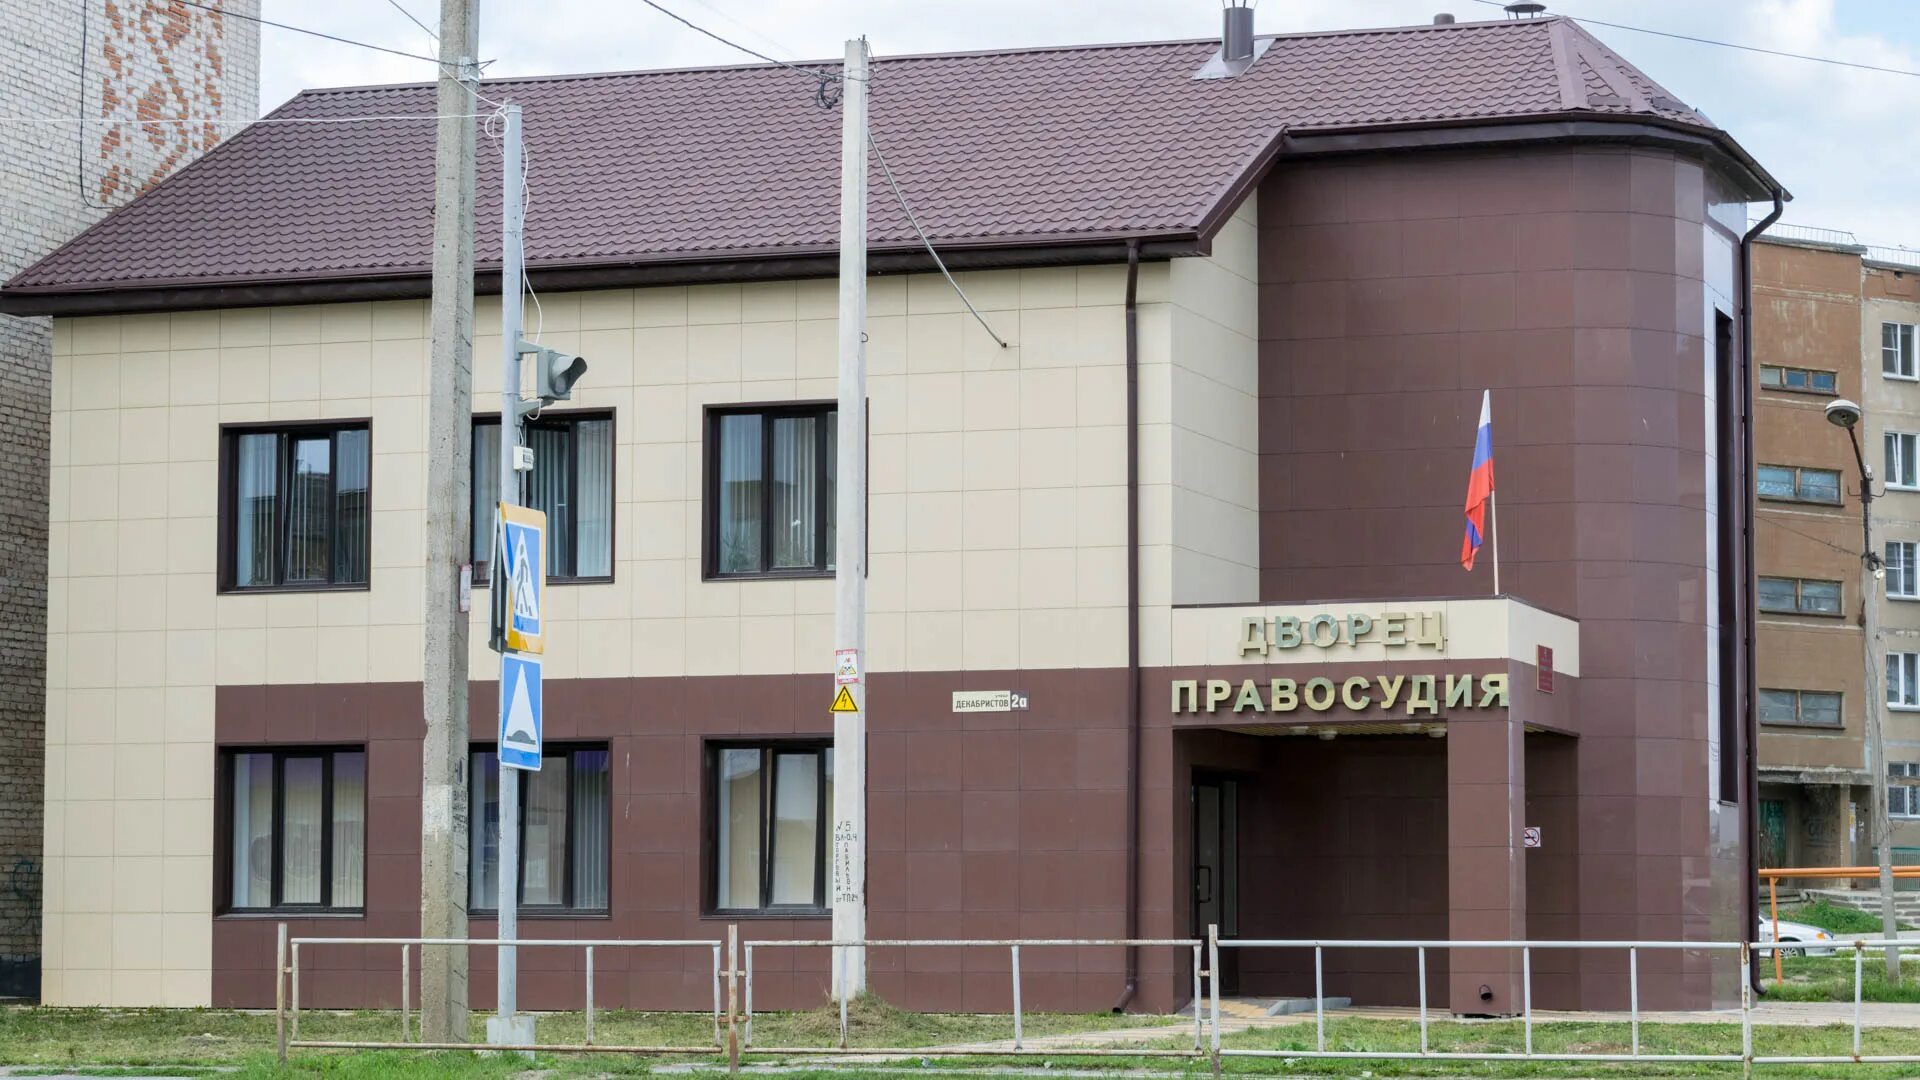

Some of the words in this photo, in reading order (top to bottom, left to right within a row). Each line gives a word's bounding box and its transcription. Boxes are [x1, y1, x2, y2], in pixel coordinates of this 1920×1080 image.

[1238, 611, 1444, 656] ДВОРЕЦ
[956, 700, 1009, 710] ДЕКАБРИСТОВ
[1171, 673, 1509, 714] ПРАВОСУДИЯ
